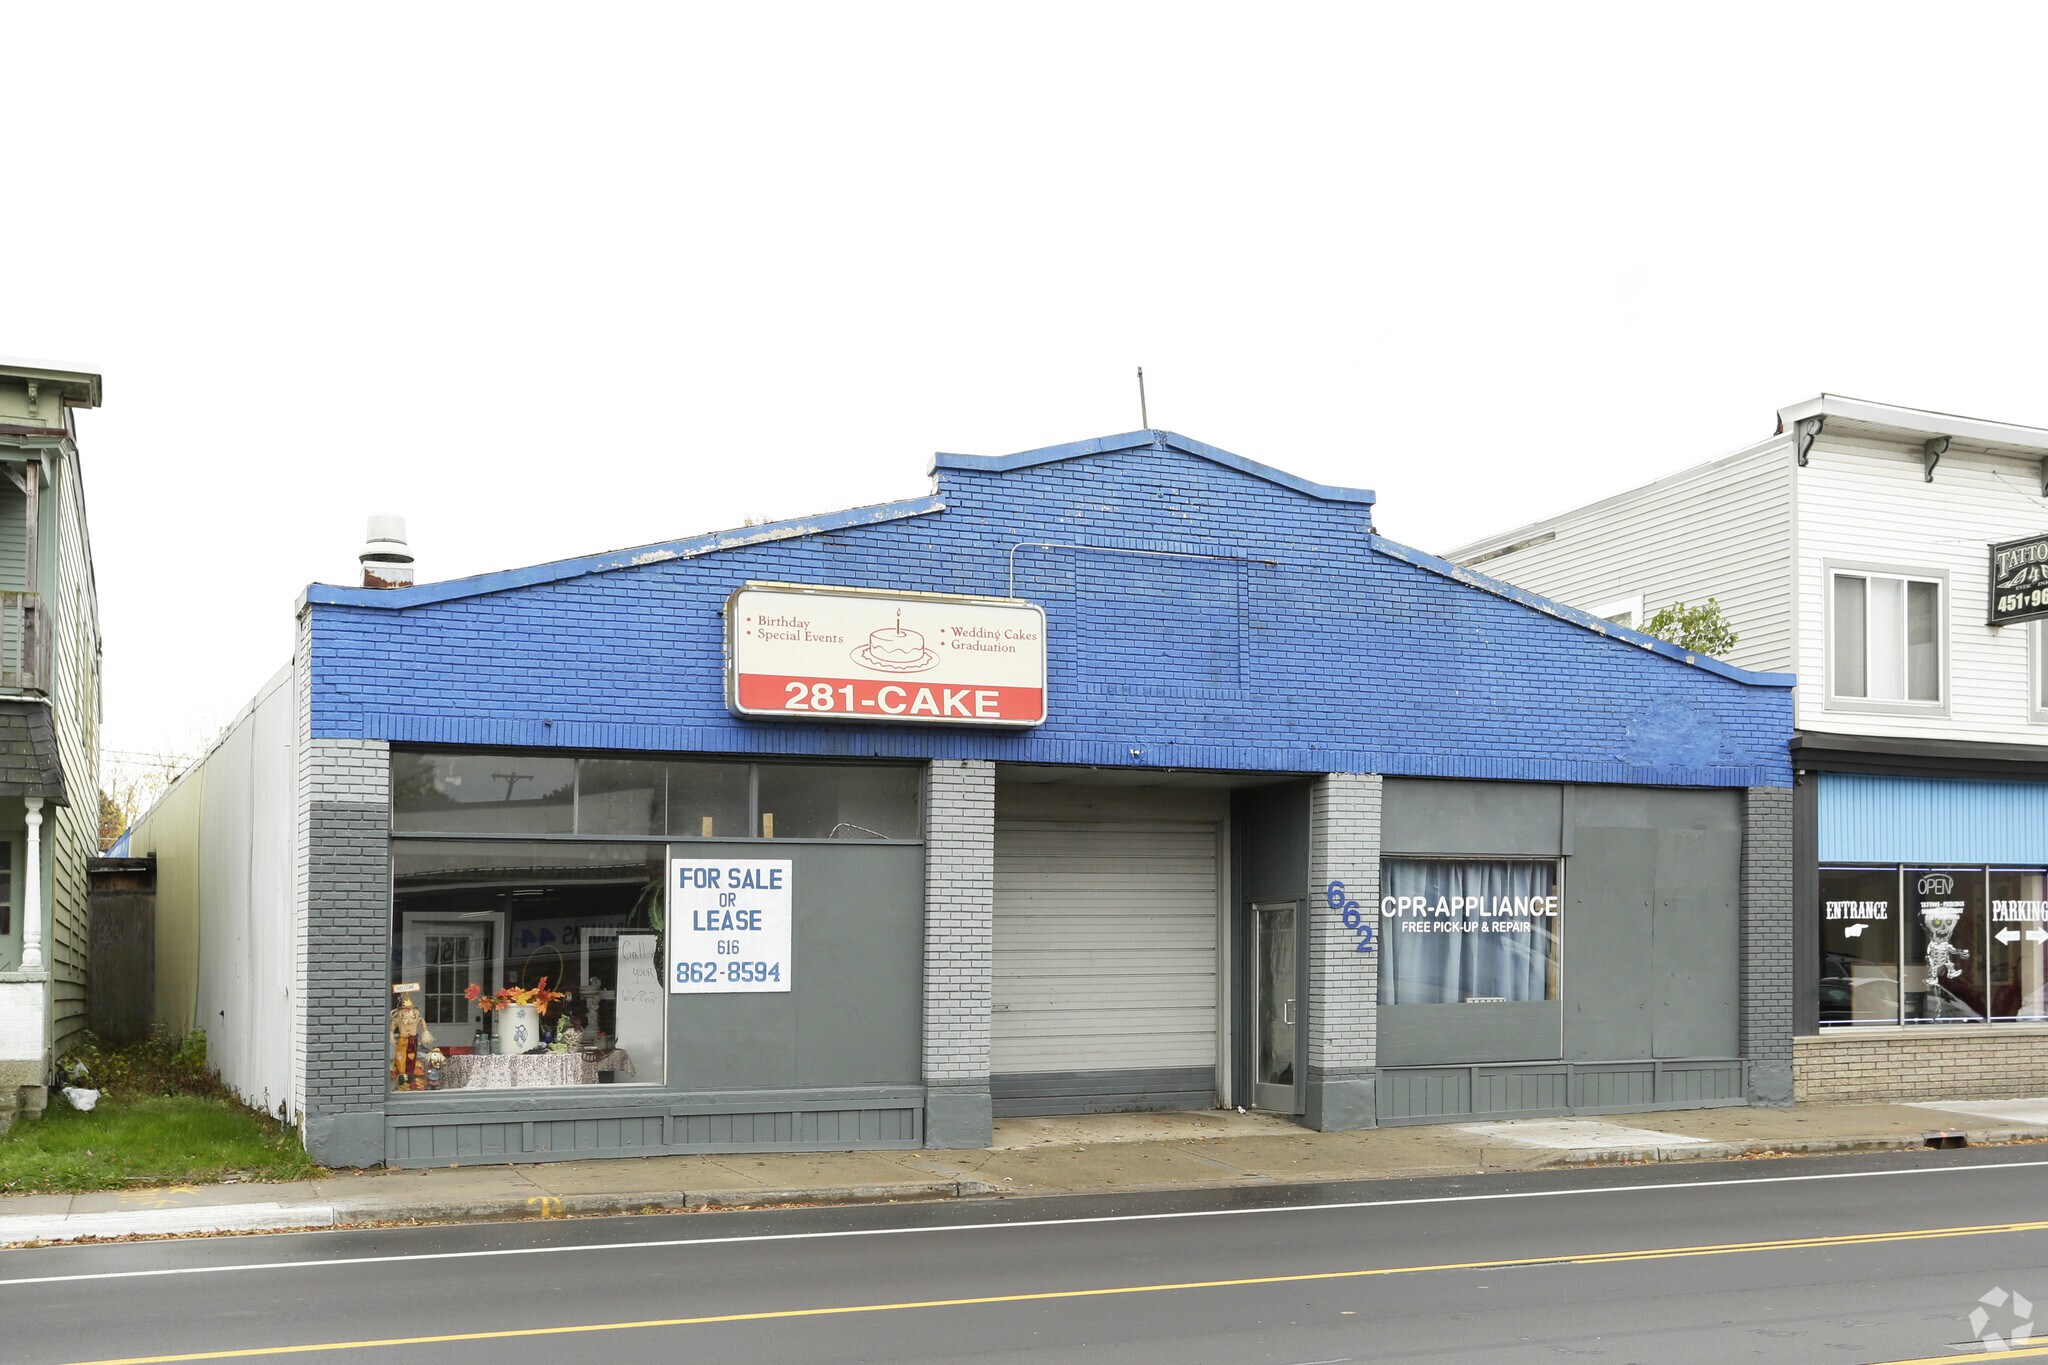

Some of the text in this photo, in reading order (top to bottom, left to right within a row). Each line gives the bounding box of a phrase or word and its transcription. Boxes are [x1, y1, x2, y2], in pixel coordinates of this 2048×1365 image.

[758, 615, 810, 630] Birthday
[758, 628, 844, 643] Special Events
[951, 626, 1037, 641] Wedding Cakes
[951, 639, 1016, 653] Graduation
[785, 681, 1001, 718] 281-CAKE
[680, 867, 783, 890] FOR SALE
[1917, 878, 1952, 895] OPEN
[719, 892, 736, 907] OR
[1381, 895, 1558, 918] CPR-APPLIANCE
[693, 909, 762, 931] LEASE
[1327, 880, 1373, 952] 662
[1825, 900, 1888, 920] ENTRANCE
[1992, 900, 2048, 922] PARKING
[1402, 921, 1531, 933] FREE PICK-UP & REPAIR
[622, 940, 646, 960] Call
[717, 939, 740, 955] 616
[676, 961, 780, 983] 862-8594
